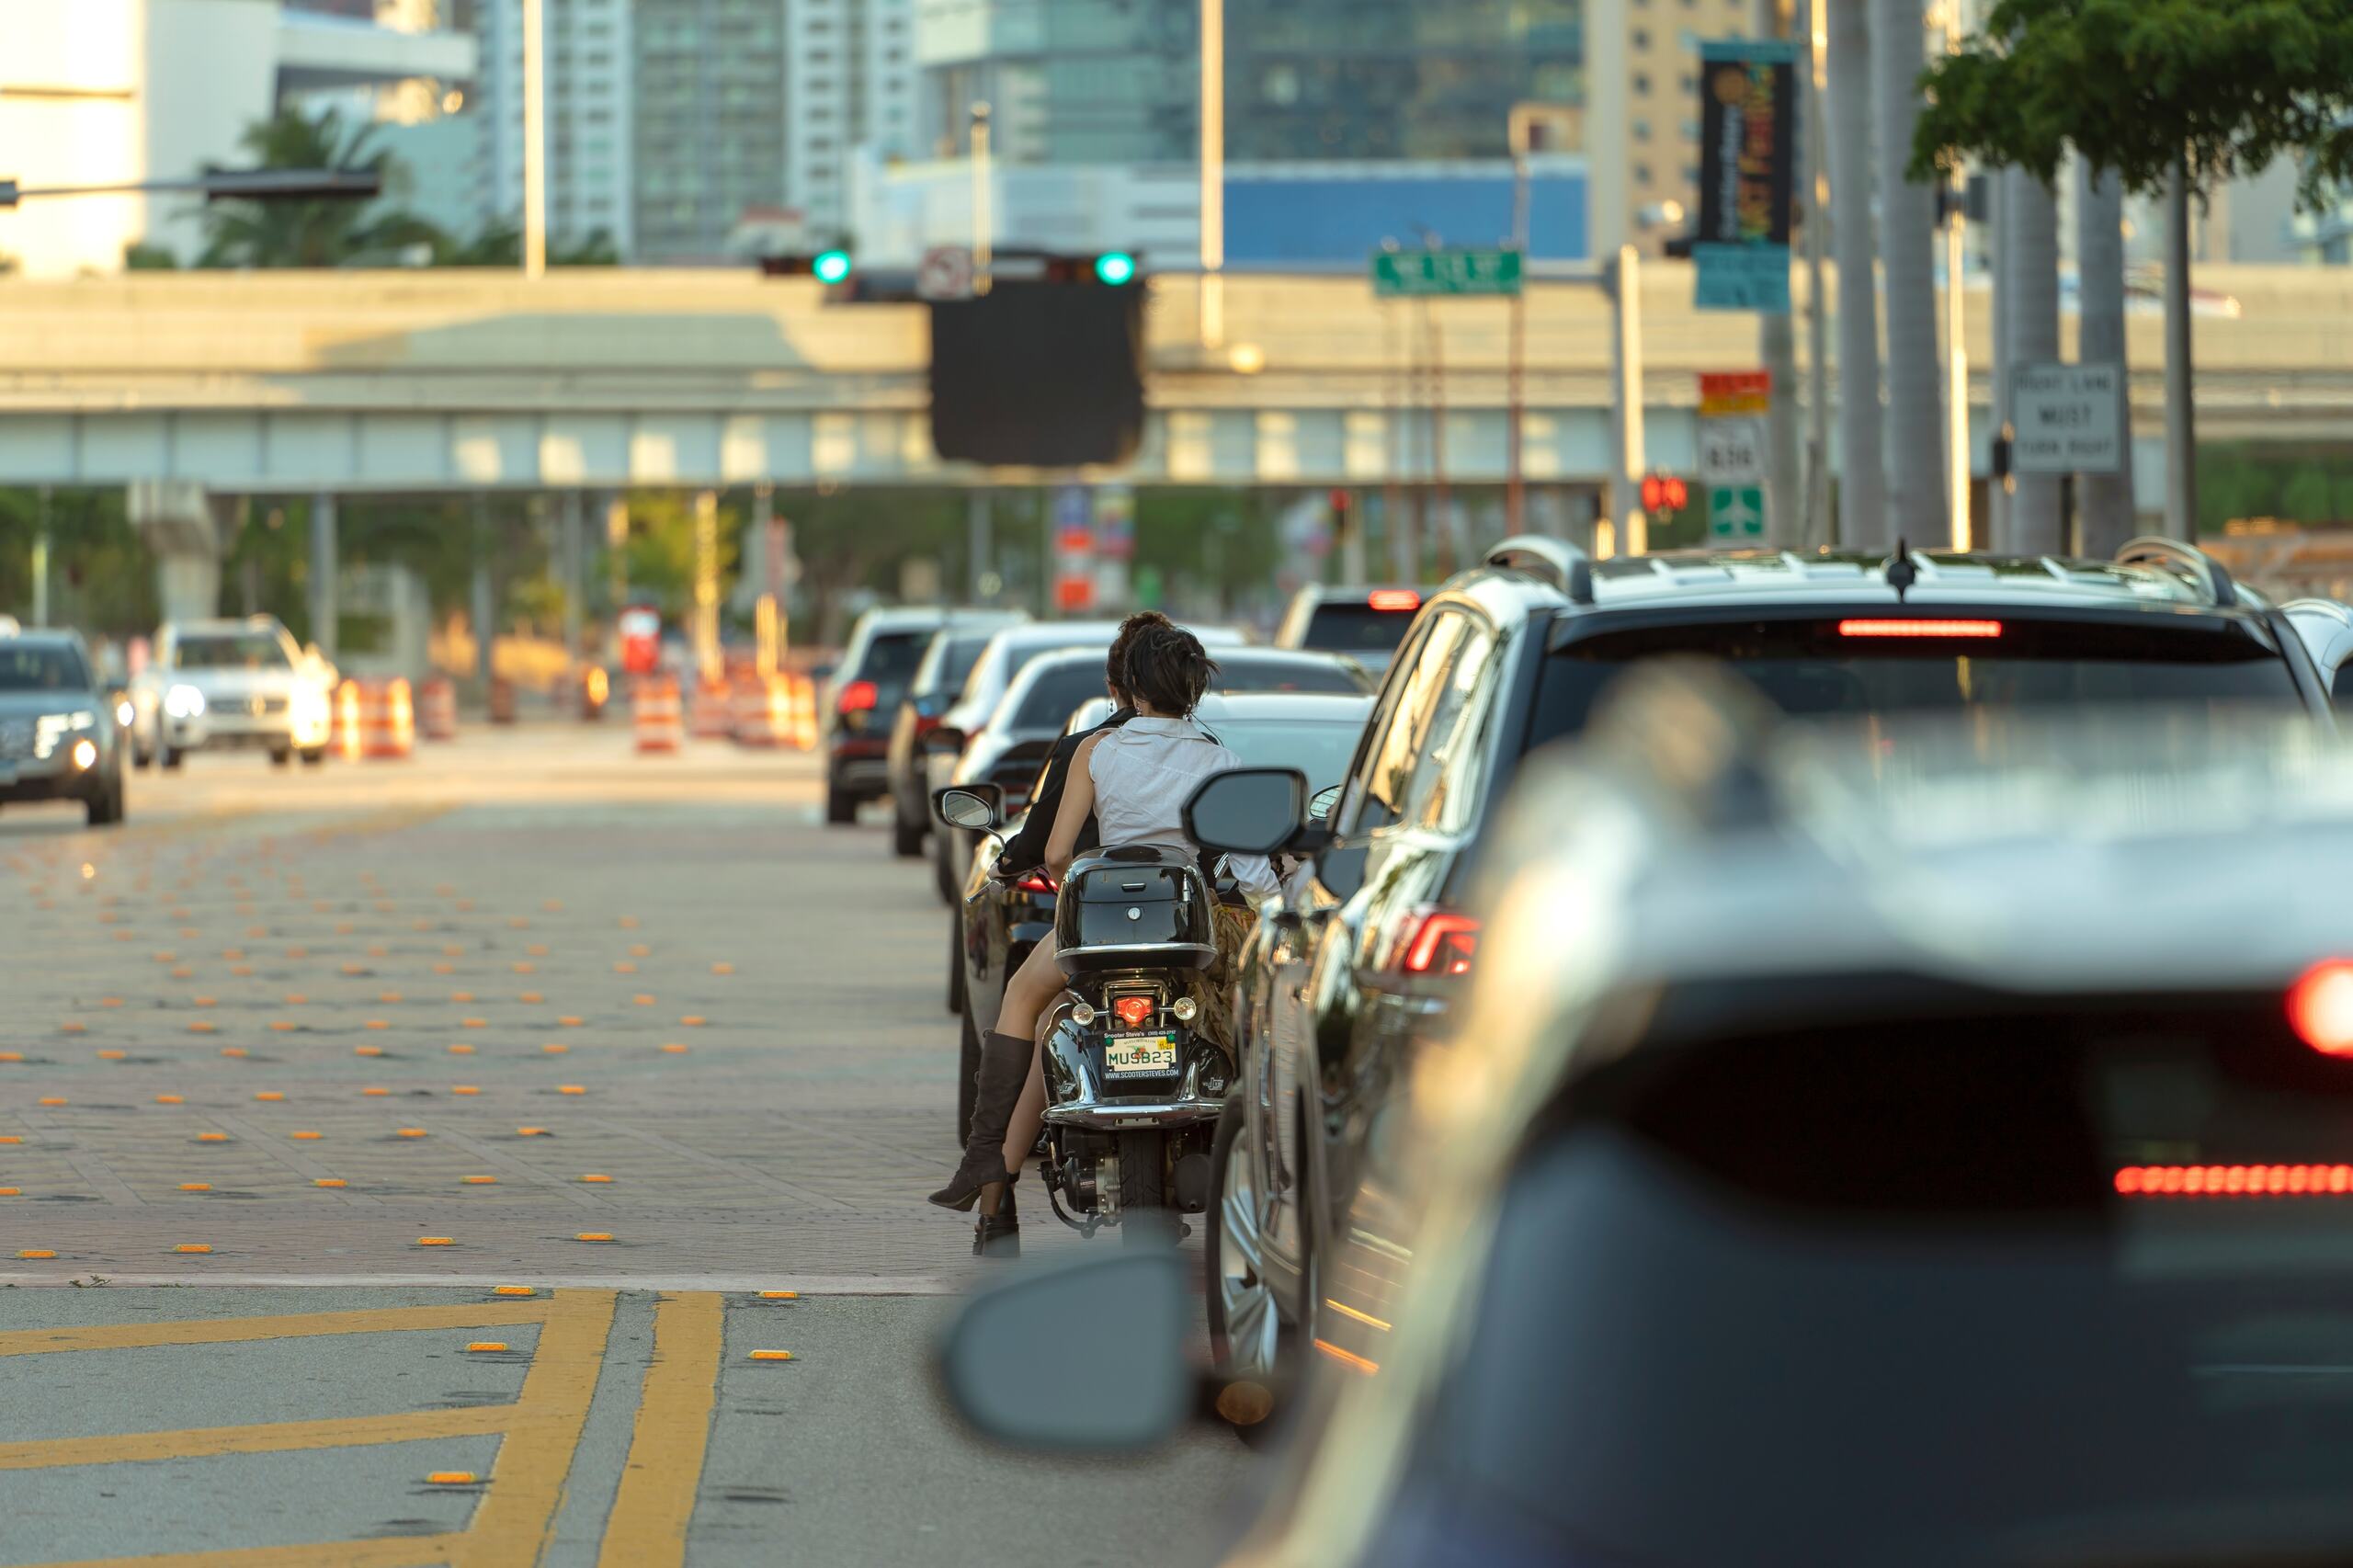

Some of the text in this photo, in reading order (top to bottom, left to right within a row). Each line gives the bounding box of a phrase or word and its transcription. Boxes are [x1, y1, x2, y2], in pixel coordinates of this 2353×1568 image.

[2039, 404, 2091, 427] MUST
[1108, 1051, 1173, 1065] MUSB23
[1105, 1070, 1179, 1080] WWW.SCOOTERSTEVES.COM
